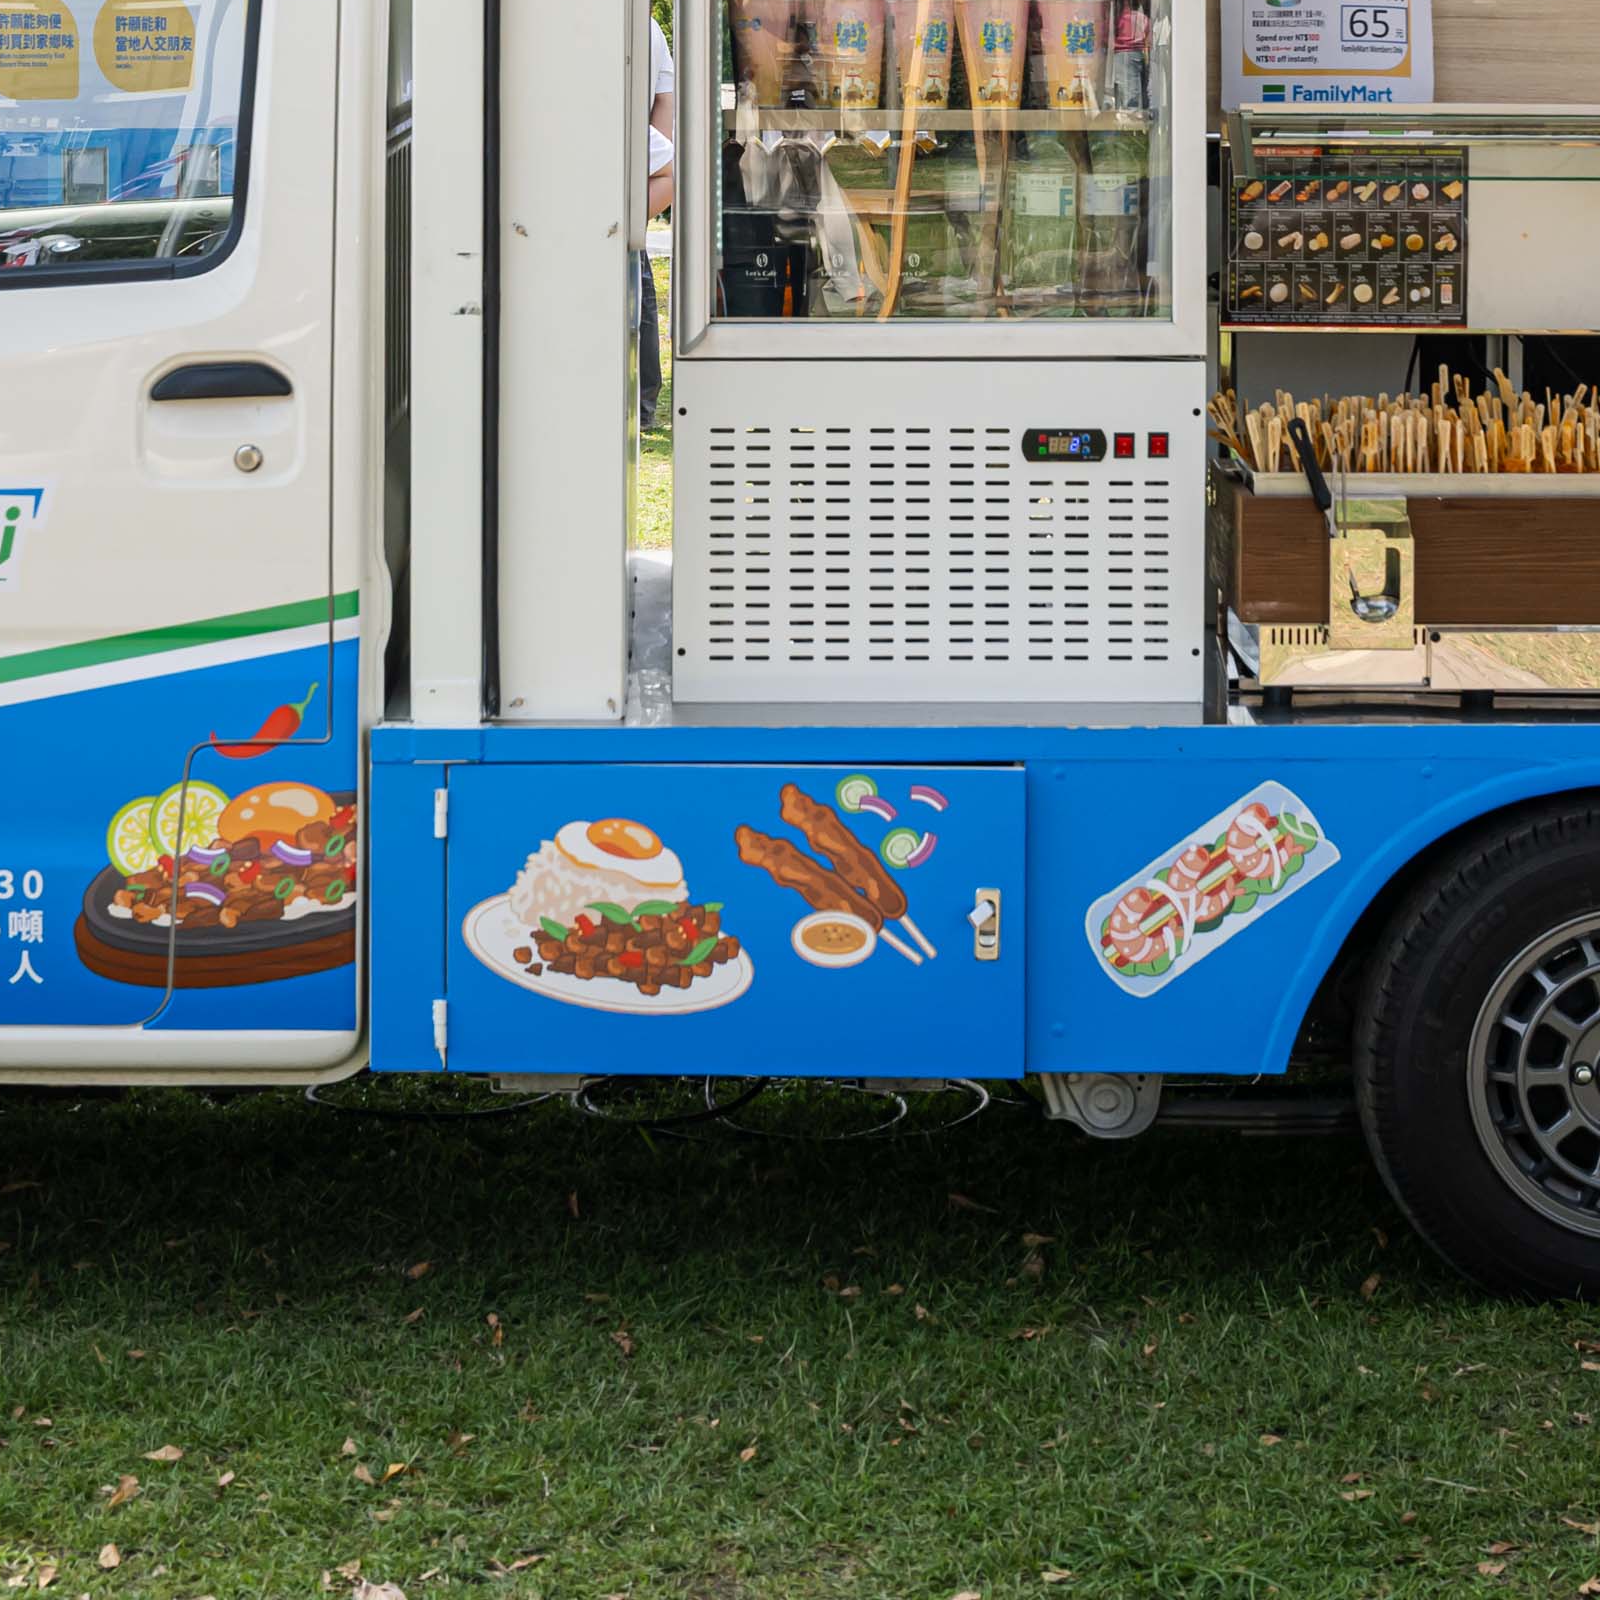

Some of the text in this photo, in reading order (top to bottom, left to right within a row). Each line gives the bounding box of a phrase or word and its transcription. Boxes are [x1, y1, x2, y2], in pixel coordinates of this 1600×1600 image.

[115, 16, 167, 32] 許願能和
[1349, 9, 1389, 38] 65
[115, 35, 193, 52] 當地人交朋友
[1256, 34, 1276, 43] Spend
[1292, 84, 1392, 103] FamilyMart
[8, 951, 45, 985] 人
